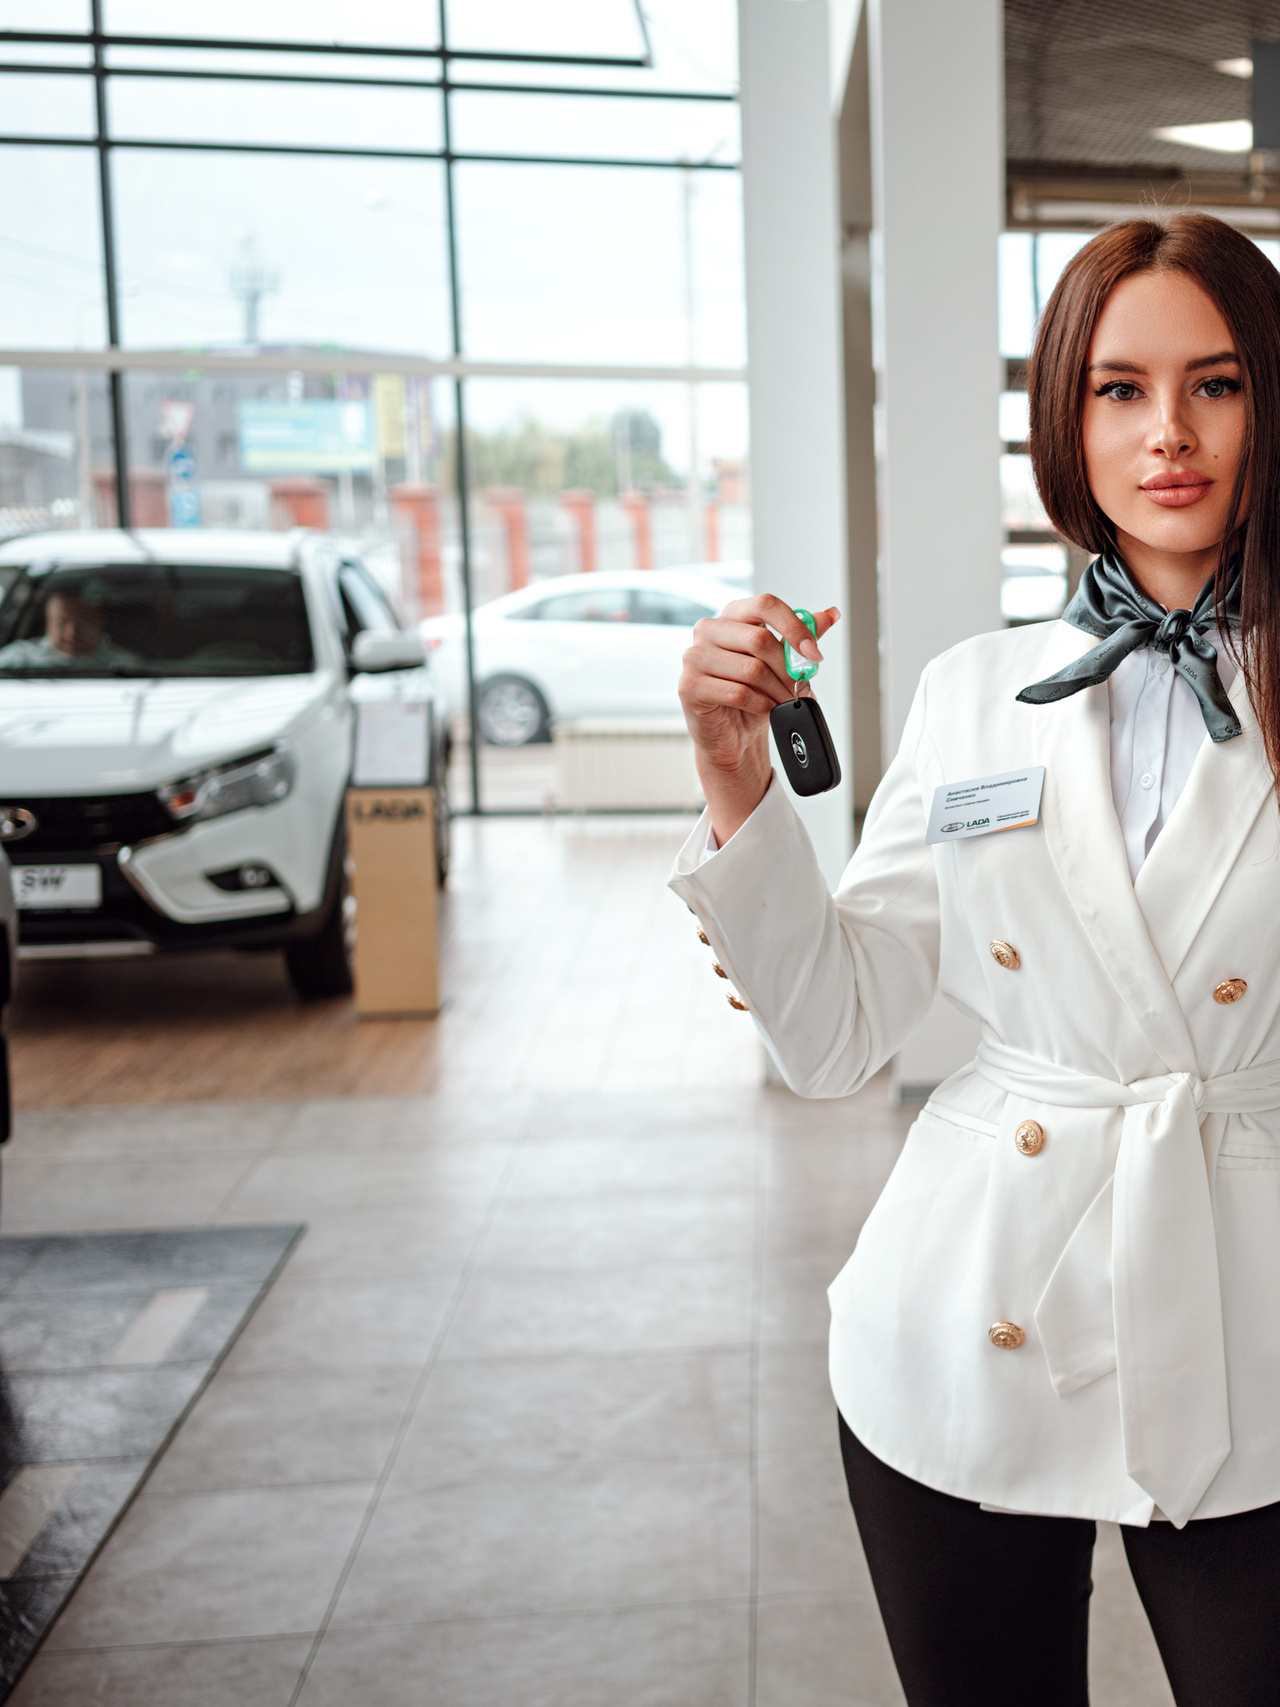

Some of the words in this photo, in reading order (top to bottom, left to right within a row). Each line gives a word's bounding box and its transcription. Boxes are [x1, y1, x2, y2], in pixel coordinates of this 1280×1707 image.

[1182, 664, 1198, 681] LADA
[353, 799, 425, 822] LADA
[966, 817, 990, 827] LADA
[21, 868, 67, 891] SW
